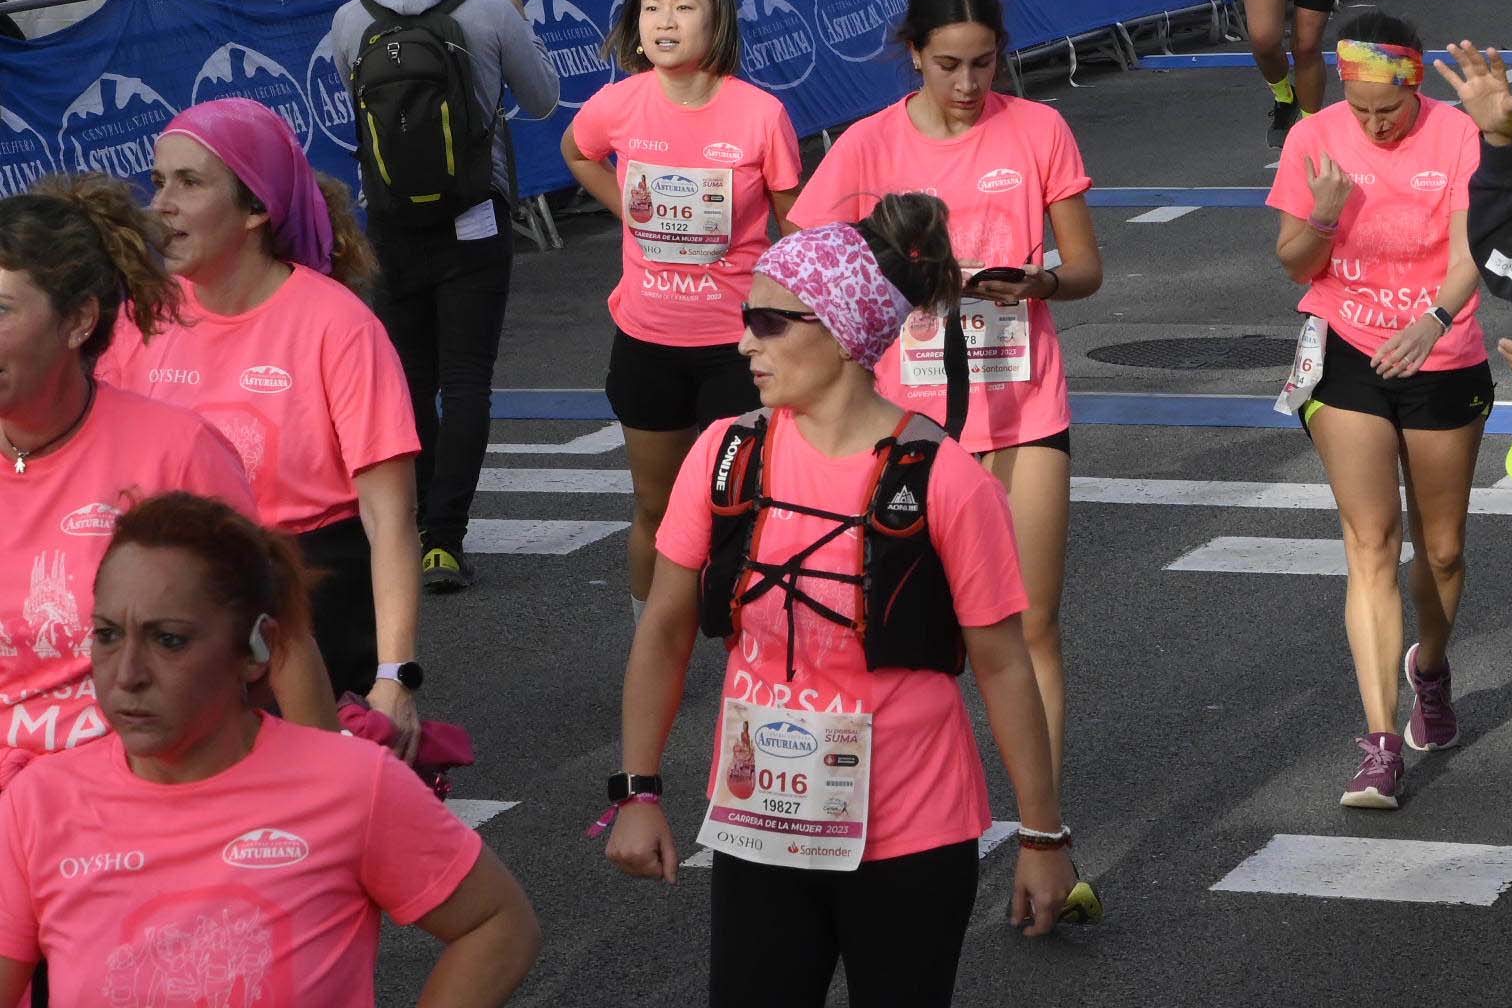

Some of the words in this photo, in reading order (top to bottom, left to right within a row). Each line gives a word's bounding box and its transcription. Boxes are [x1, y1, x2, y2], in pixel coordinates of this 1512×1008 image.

[628, 138, 669, 153] OYSHO
[654, 181, 696, 194] ASTURIANA
[656, 204, 693, 220] 016
[660, 221, 688, 232] 15122
[681, 235, 703, 243] MUJER
[1332, 257, 1361, 281] TU
[643, 269, 719, 293] SUMA
[915, 351, 944, 359] CARRER
[149, 368, 200, 385] OYSHO
[981, 364, 1020, 374] Santander
[243, 374, 291, 389] ASTURIANA
[758, 734, 812, 752] ASTURIANA
[825, 734, 858, 744] SUMA
[758, 768, 808, 795] 016
[762, 798, 801, 815] 19827
[728, 812, 764, 827] CARRERA
[765, 819, 777, 828] DE
[778, 820, 789, 830] LA
[790, 823, 822, 833] MUJER
[825, 825, 849, 834] 2023
[717, 831, 763, 851] OYSHO
[229, 845, 303, 862] ASTURIANA
[800, 844, 852, 858] Santander
[60, 850, 145, 880] OYSHO
